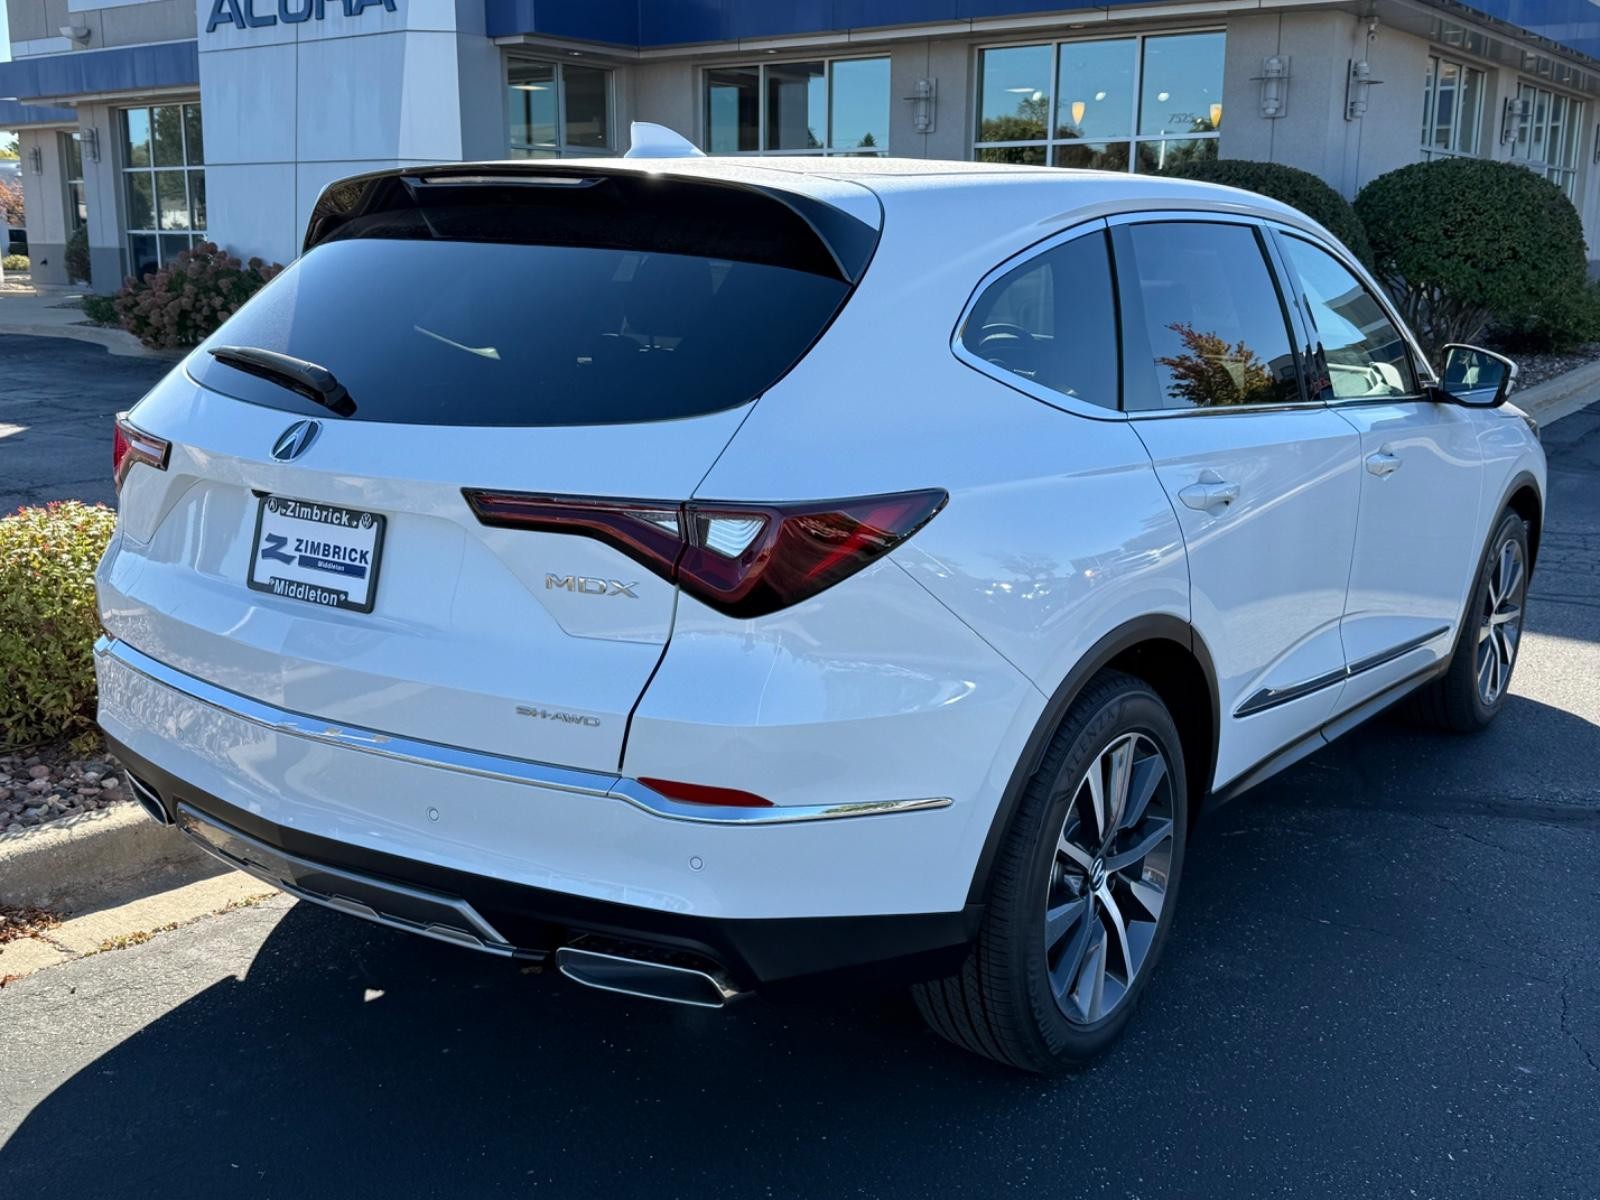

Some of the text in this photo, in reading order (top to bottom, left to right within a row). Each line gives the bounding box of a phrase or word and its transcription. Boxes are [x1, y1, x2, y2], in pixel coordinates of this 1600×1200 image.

[286, 501, 350, 526] Zimbrick
[294, 538, 370, 565] ZIMBRICK
[317, 561, 345, 572] Middleton
[273, 578, 338, 605] Middleton
[545, 573, 640, 599] MDX
